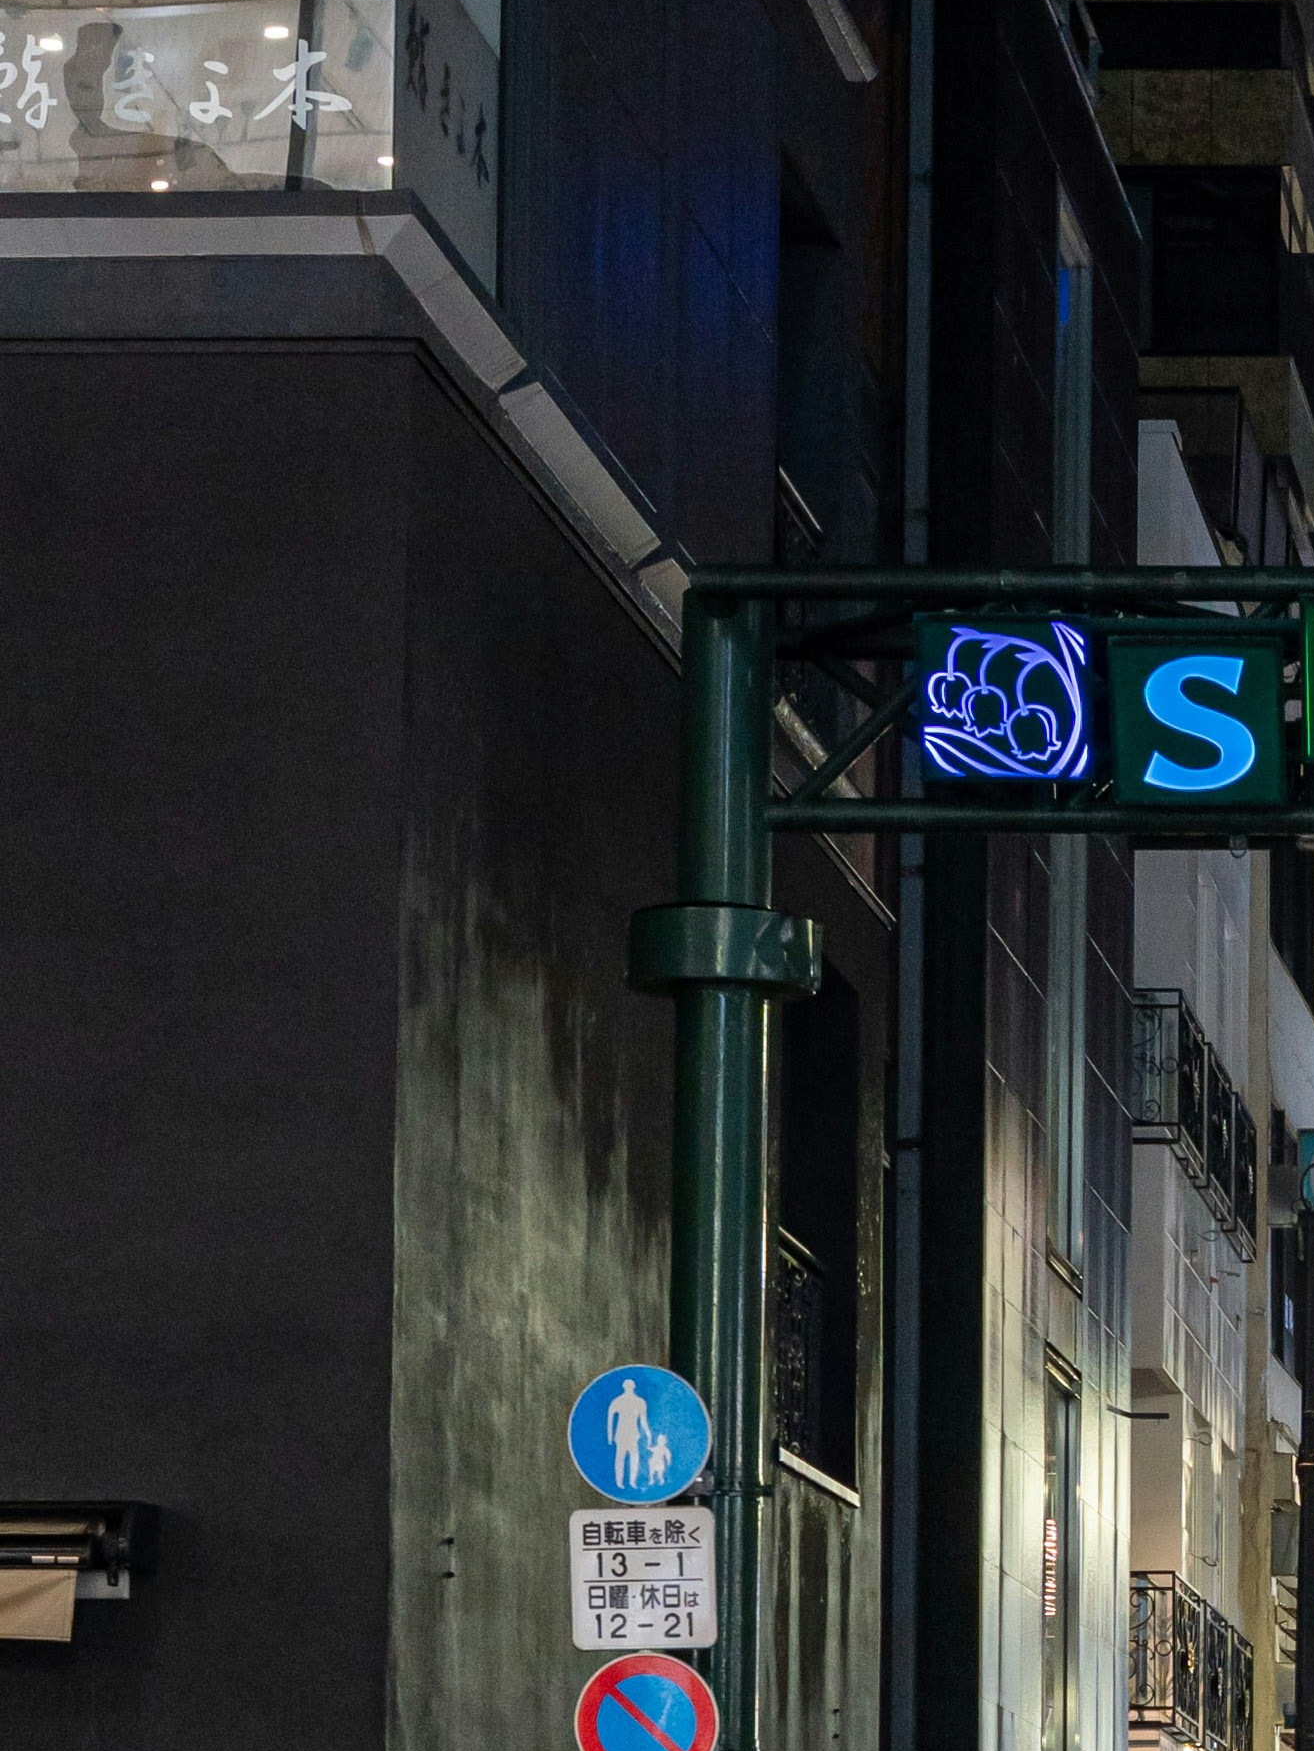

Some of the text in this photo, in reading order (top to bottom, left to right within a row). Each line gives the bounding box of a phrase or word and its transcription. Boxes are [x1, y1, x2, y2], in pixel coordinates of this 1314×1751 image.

[582, 1519, 702, 1546] 自転車を除く
[588, 1584, 700, 1610] 日曜・休日は
